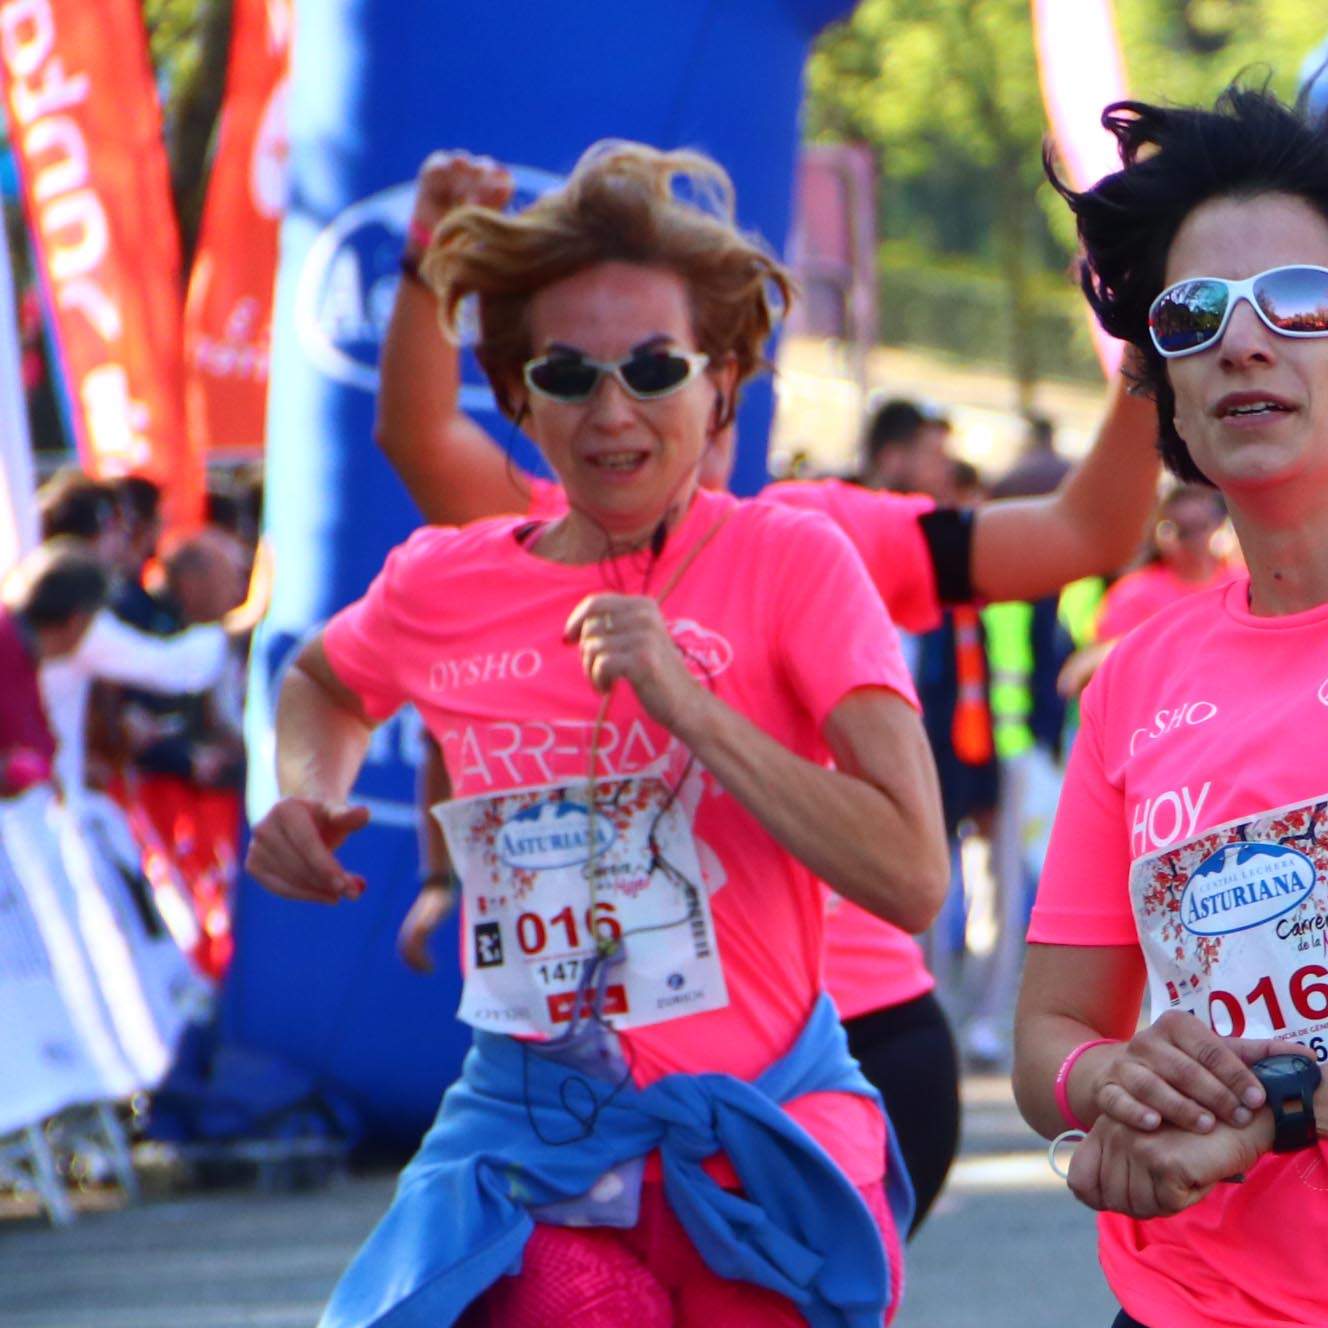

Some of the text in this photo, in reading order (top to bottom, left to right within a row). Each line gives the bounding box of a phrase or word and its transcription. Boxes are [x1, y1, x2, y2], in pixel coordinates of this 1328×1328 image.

[429, 648, 543, 693] OYSHO
[1131, 781, 1212, 858] HOY
[1240, 858, 1296, 880] LECHERA
[1187, 870, 1308, 926] ASTURIANA
[516, 902, 623, 956] 016
[1297, 939, 1310, 952] de
[1311, 934, 1322, 947] la
